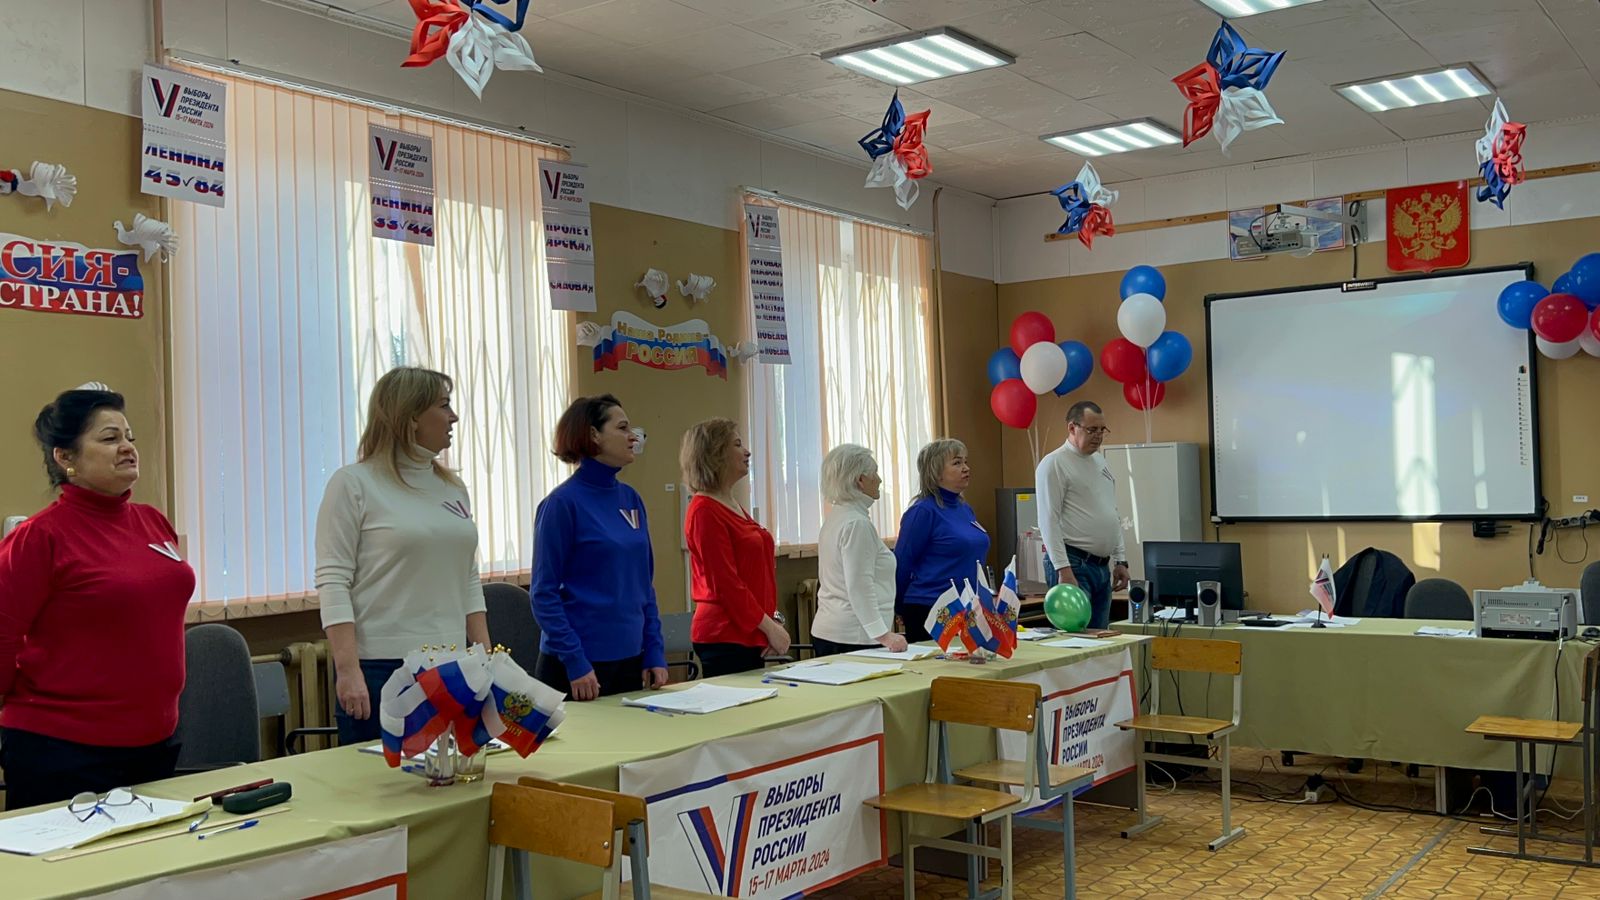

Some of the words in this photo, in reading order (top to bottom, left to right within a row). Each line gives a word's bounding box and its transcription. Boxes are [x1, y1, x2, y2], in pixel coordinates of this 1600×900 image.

[180, 96, 220, 113] ПРЕЗИДЕНТА
[183, 86, 212, 101] ВЫБОРЫ
[177, 105, 203, 118] РОССИИ
[144, 142, 224, 173] ЛЕНИНА
[399, 142, 422, 153] ВЫБОРЫ
[394, 158, 415, 169] РОССИИ
[371, 194, 433, 216] ЛЕНИНА
[0, 282, 140, 316] СТРАНА!
[617, 321, 655, 340] Наша
[626, 341, 698, 366] РОССИЯ
[1064, 697, 1099, 722] ВЫБОРЫ
[1062, 714, 1106, 743] ПРЕЗИДЕНТА
[1062, 740, 1088, 765] РОССИИ
[764, 772, 825, 809] ВЫБОРЫ
[757, 793, 842, 839] ПРЕЗИДЕНТА
[752, 831, 807, 870] РОССИИ
[774, 859, 807, 887] МАРТА
[807, 848, 831, 874] 2024
